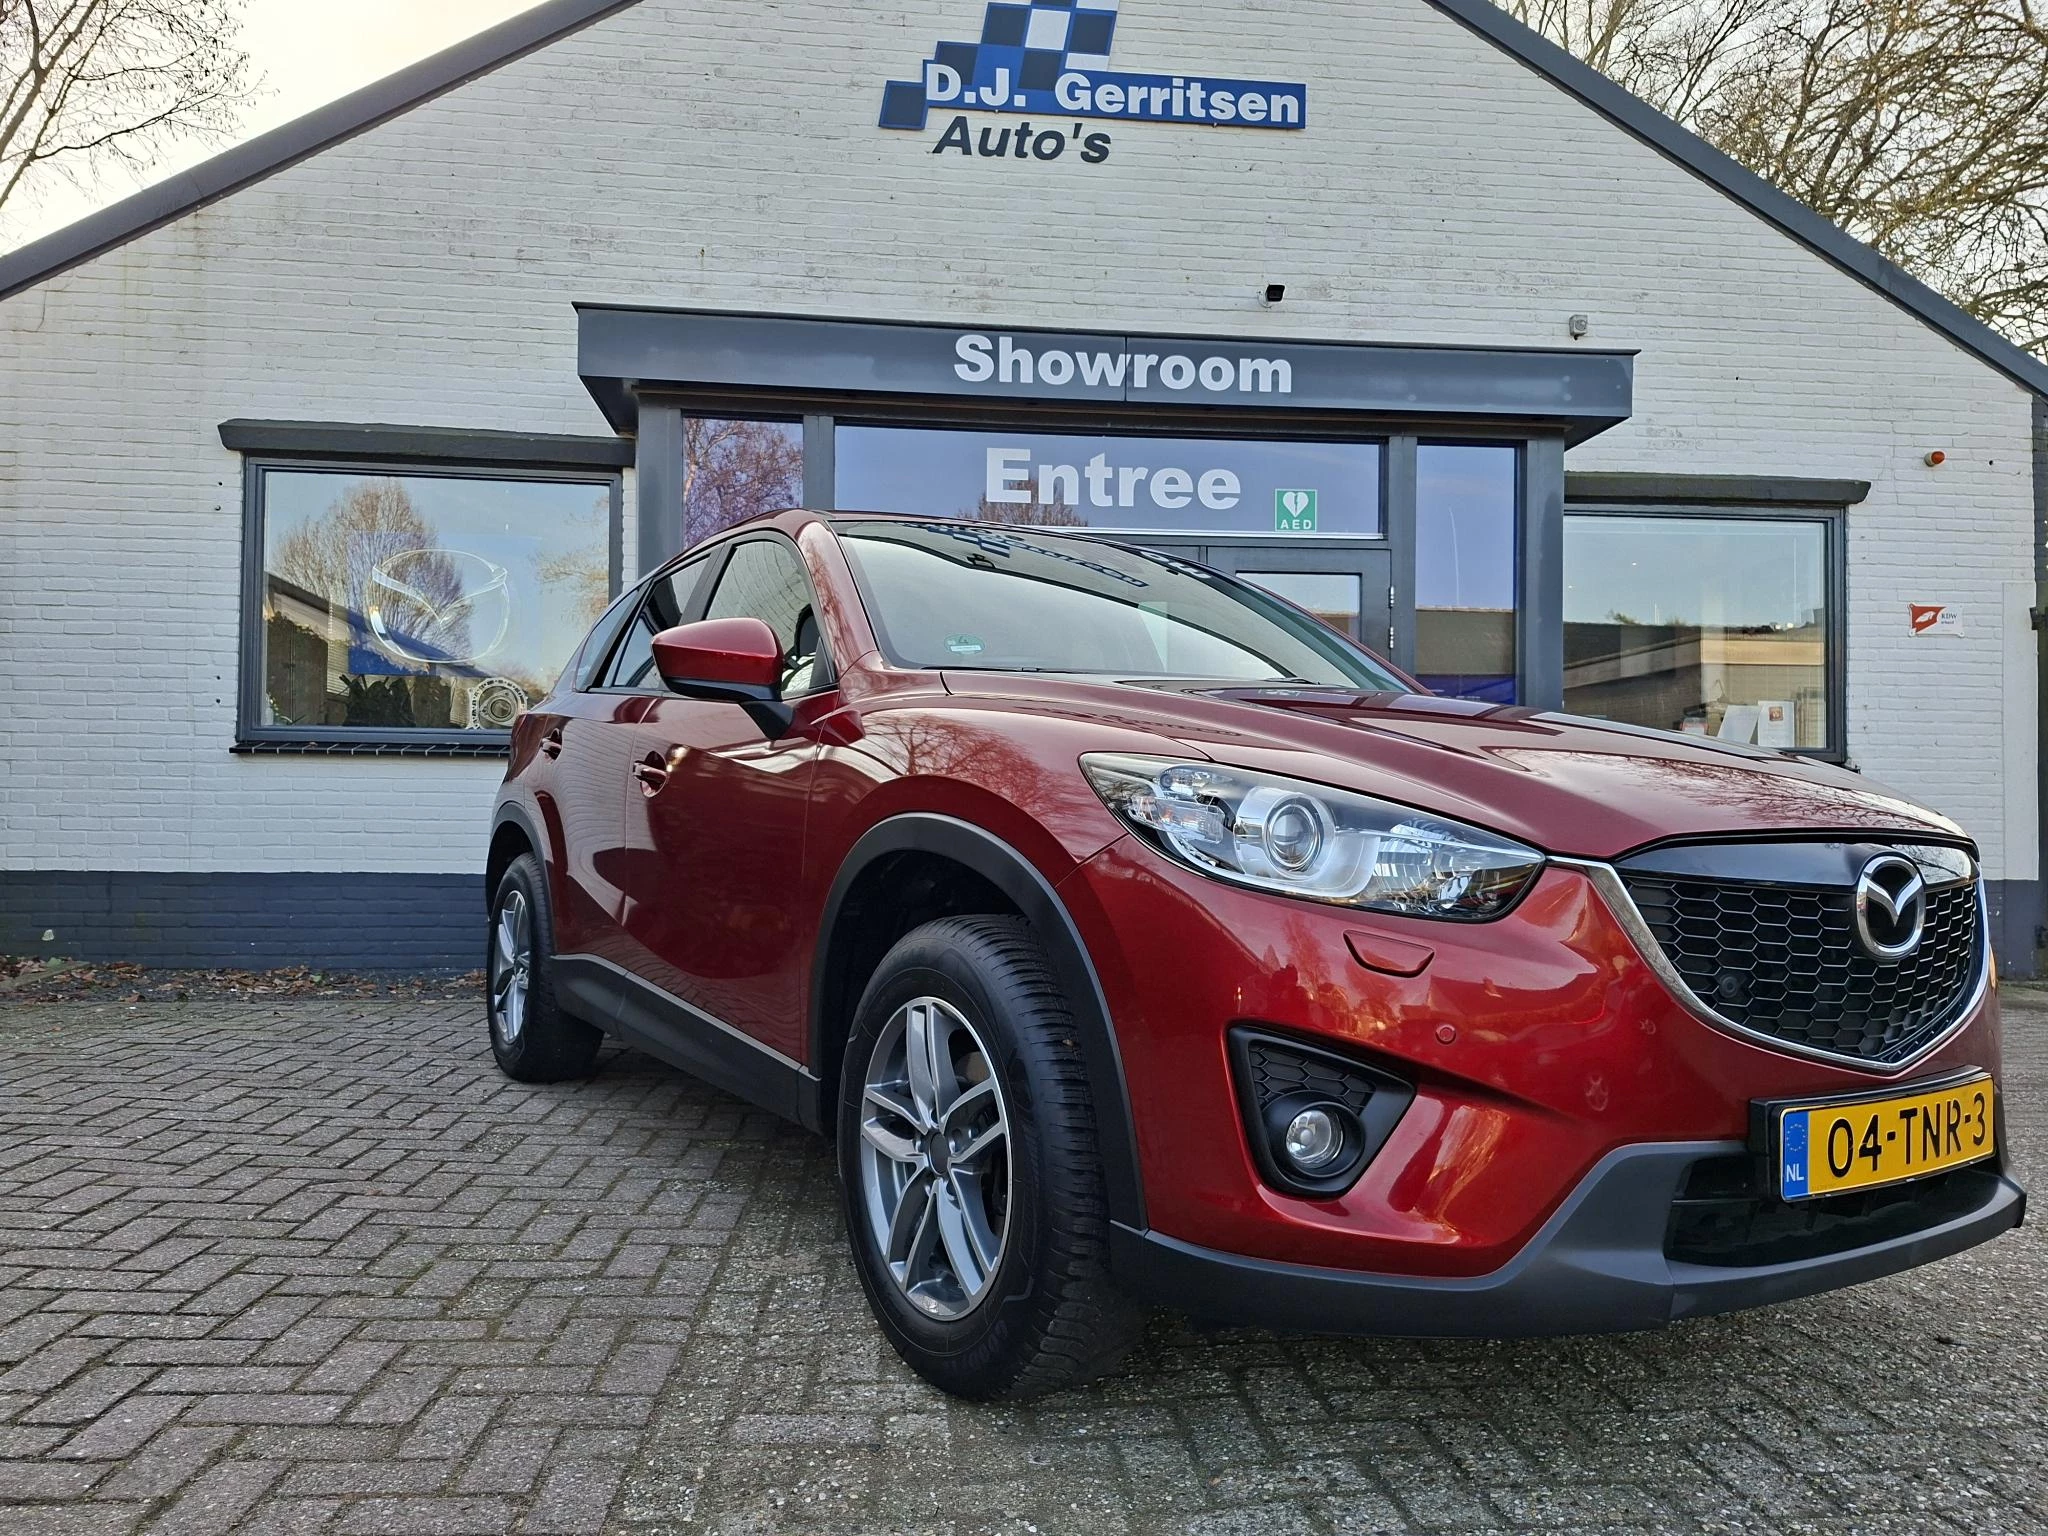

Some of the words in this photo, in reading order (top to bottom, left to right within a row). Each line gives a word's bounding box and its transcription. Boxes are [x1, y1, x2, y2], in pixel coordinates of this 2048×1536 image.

[926, 63, 1026, 107] D.J.
[1055, 72, 1299, 123] Gerritsen
[932, 115, 1112, 163] Auto's
[954, 334, 1292, 393] Showroom
[986, 447, 1241, 510] Entree
[1280, 519, 1312, 530] AED
[1827, 1091, 1986, 1178] 04-TNR-3
[1786, 1164, 1805, 1183] NL
